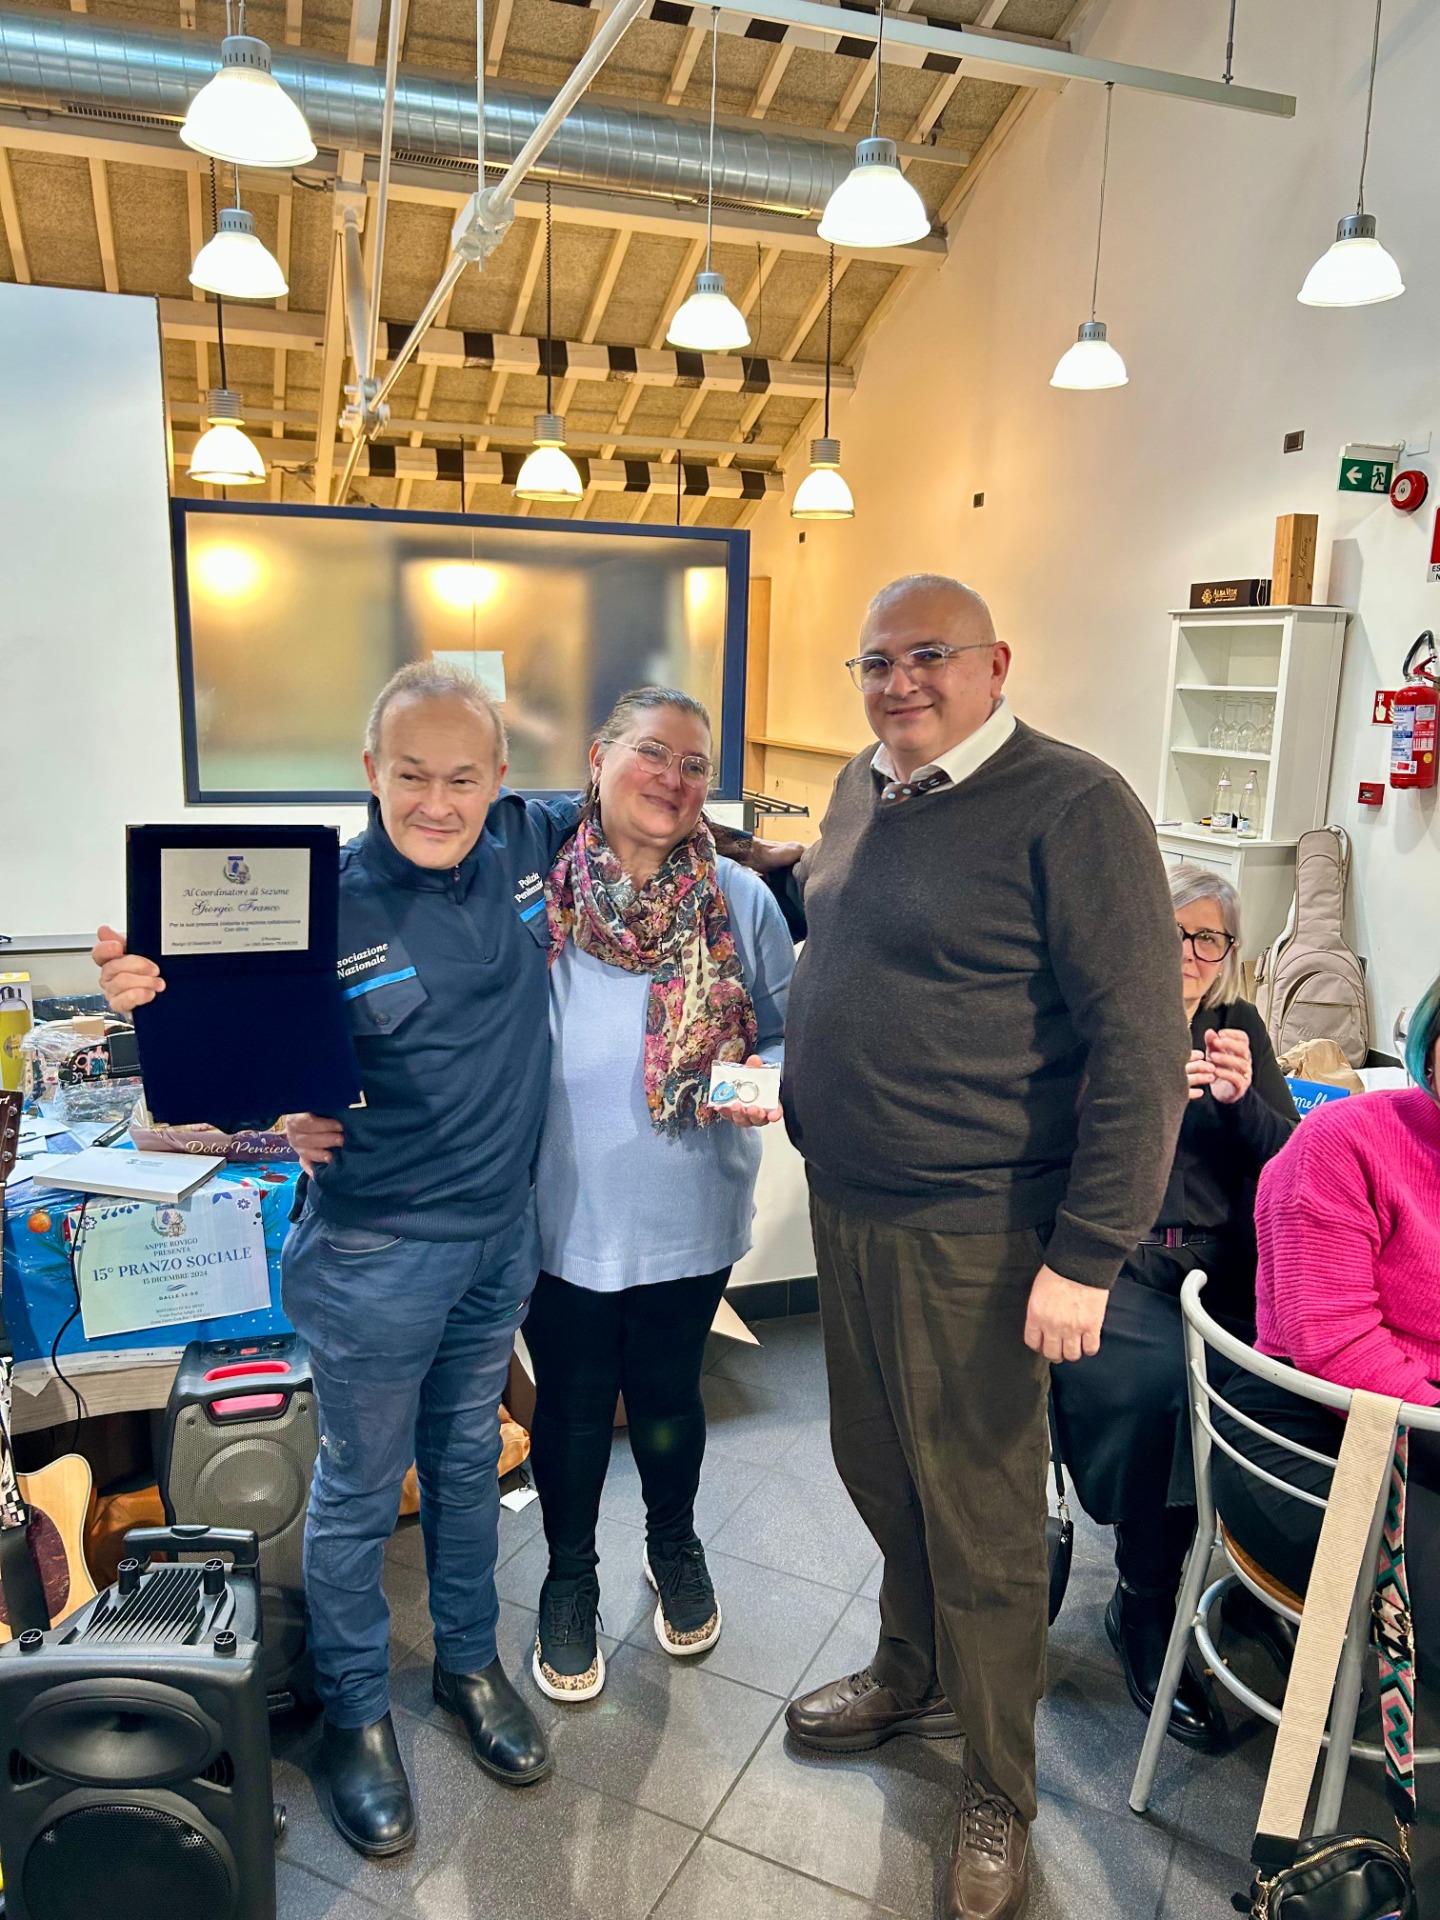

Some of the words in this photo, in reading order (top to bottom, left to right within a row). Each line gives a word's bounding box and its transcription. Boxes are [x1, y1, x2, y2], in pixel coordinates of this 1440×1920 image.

[196, 888, 248, 897] Coordinatore
[250, 888, 258, 896] di
[261, 888, 290, 896] Sezione
[192, 900, 234, 917] Giorgio
[238, 899, 280, 912] Franco
[336, 954, 386, 980] Nazionale
[185, 1140, 228, 1154] Dolci
[230, 1140, 292, 1154] Pensieri
[144, 1240, 168, 1251] ANPPE
[170, 1236, 198, 1247] ROVIGO
[153, 1246, 192, 1257] PRESENTA
[92, 1267, 114, 1282] 15°
[118, 1258, 182, 1278] PRANZO
[186, 1246, 252, 1268] SOCIALE
[150, 1272, 188, 1284] DICEMBRE
[191, 1270, 208, 1278] 2024
